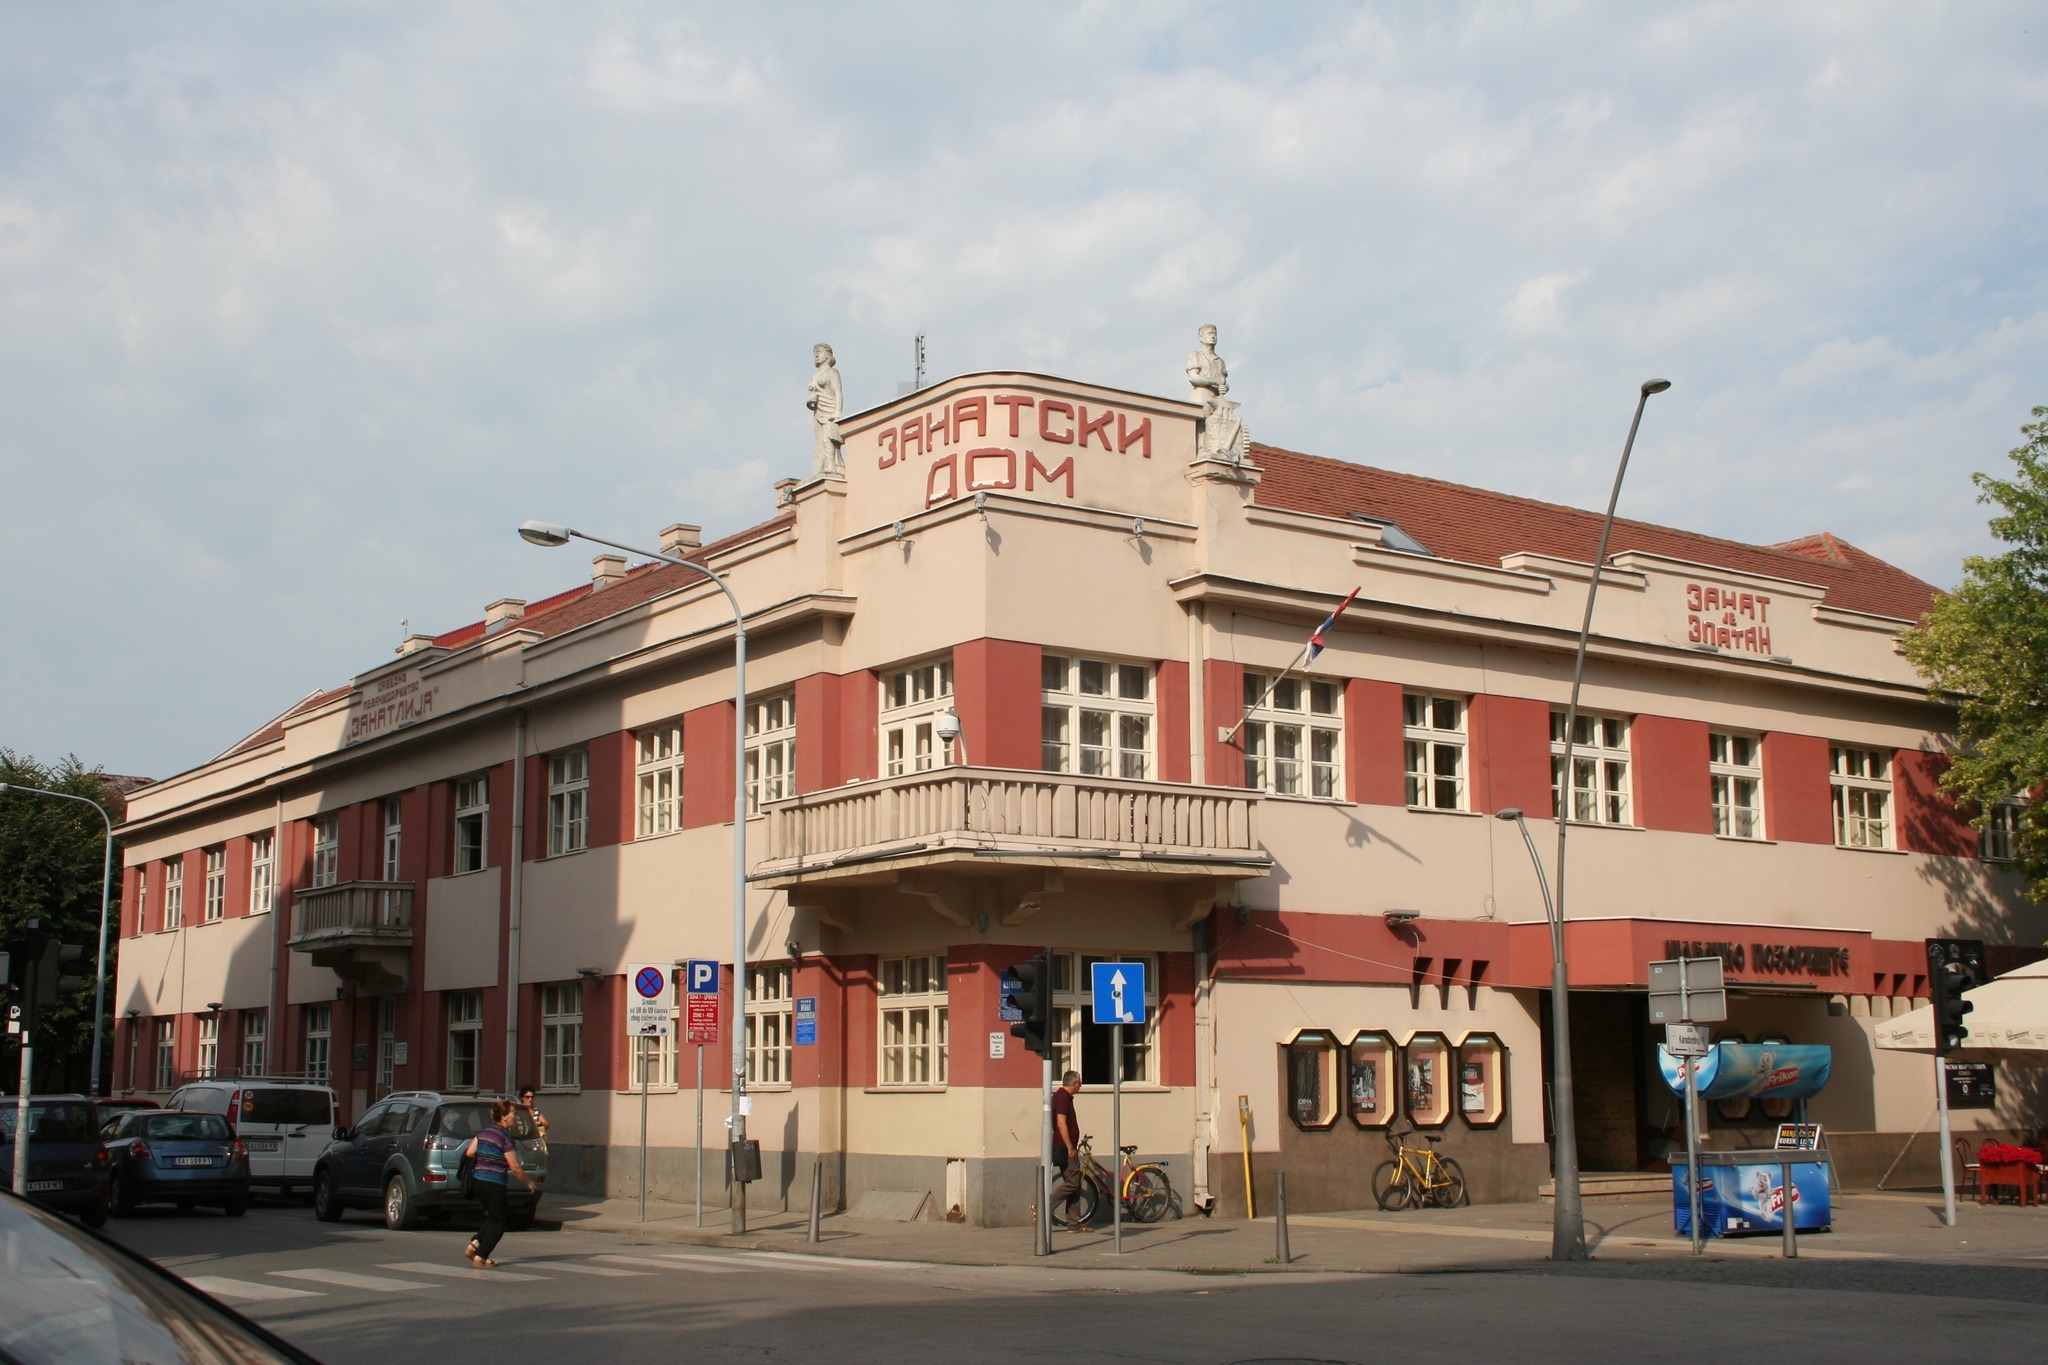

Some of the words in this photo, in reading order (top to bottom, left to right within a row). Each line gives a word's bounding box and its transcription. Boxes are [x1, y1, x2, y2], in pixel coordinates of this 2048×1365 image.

[878, 395, 1151, 469] ЗАНАТСКИ
[925, 447, 1074, 509] ДОМ
[1686, 584, 1770, 623] ЗАНАТ
[1688, 614, 1771, 655] ЗЛАТАН
[694, 964, 713, 989] P
[1751, 943, 1849, 977] ПОЗОРИШТЕ
